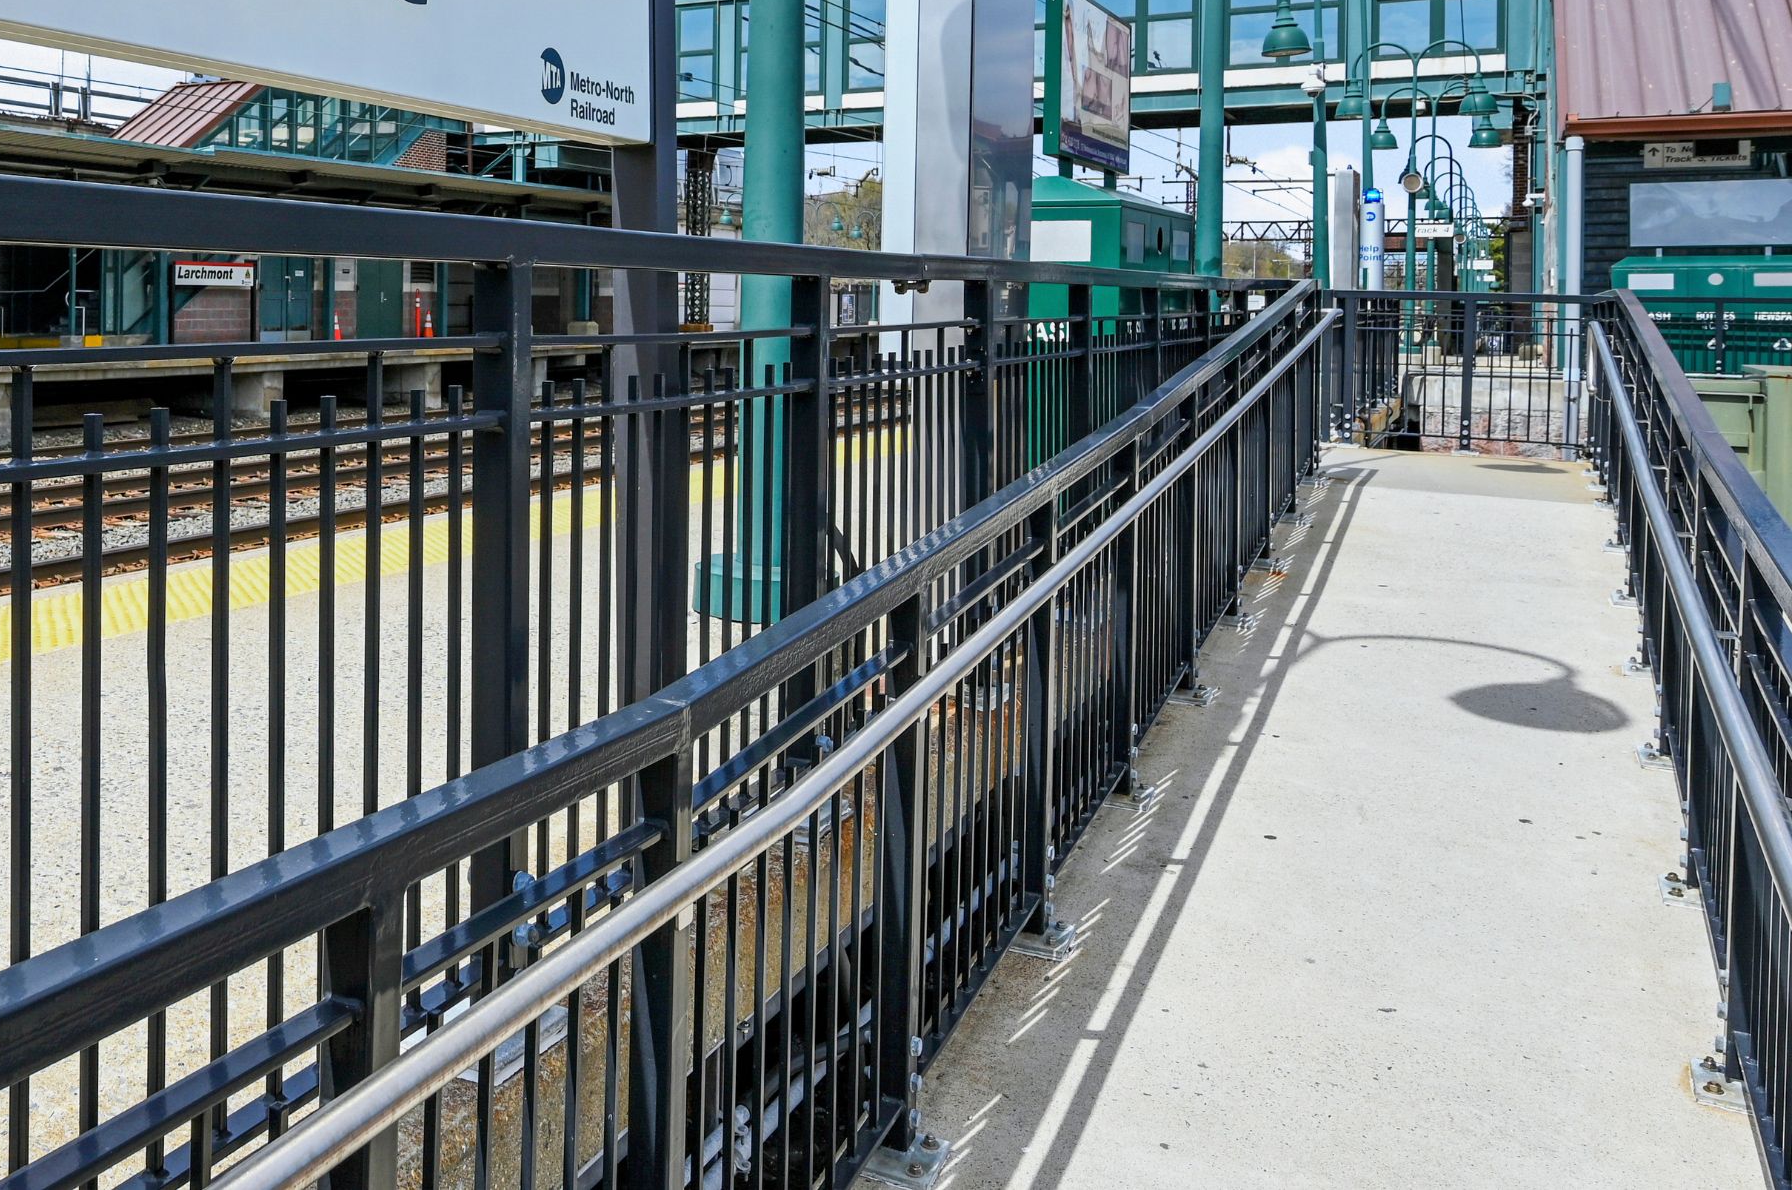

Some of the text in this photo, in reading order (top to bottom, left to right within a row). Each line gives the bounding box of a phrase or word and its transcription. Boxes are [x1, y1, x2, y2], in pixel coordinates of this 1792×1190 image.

[570, 71, 635, 105] Metro-North
[570, 98, 615, 125] Railroad
[1664, 155, 1692, 163] Track
[1359, 245, 1380, 254] Help
[1359, 253, 1383, 262] Point
[177, 265, 234, 280] Larchmont
[1648, 311, 1672, 321] ASH
